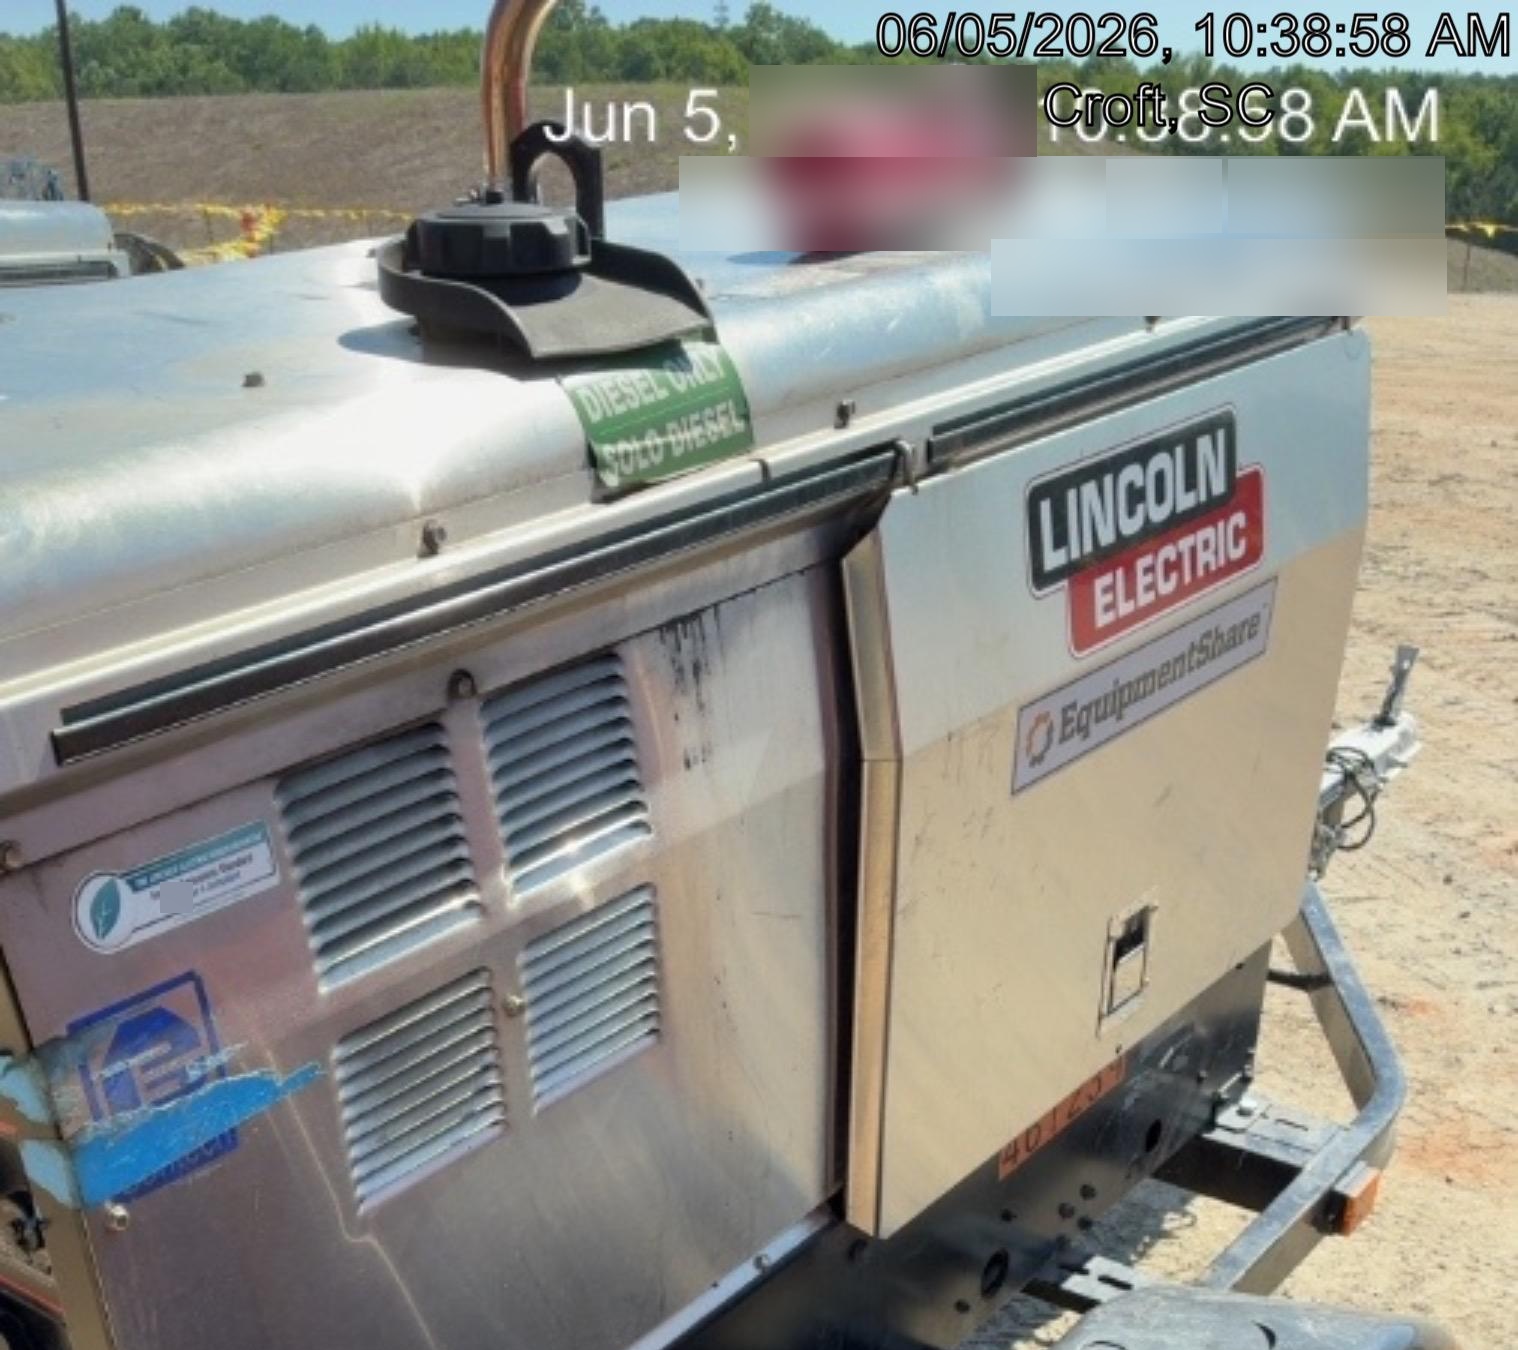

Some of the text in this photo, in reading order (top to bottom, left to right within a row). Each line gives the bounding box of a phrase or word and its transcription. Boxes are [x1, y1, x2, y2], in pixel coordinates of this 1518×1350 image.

[576, 344, 725, 424] DIESEL ONLY
[600, 399, 745, 487] SOLO DIESEL
[1040, 428, 1226, 574] LINCOLN
[1094, 511, 1248, 629] ELECTRIC
[1058, 608, 1263, 746] EquipmentShare
